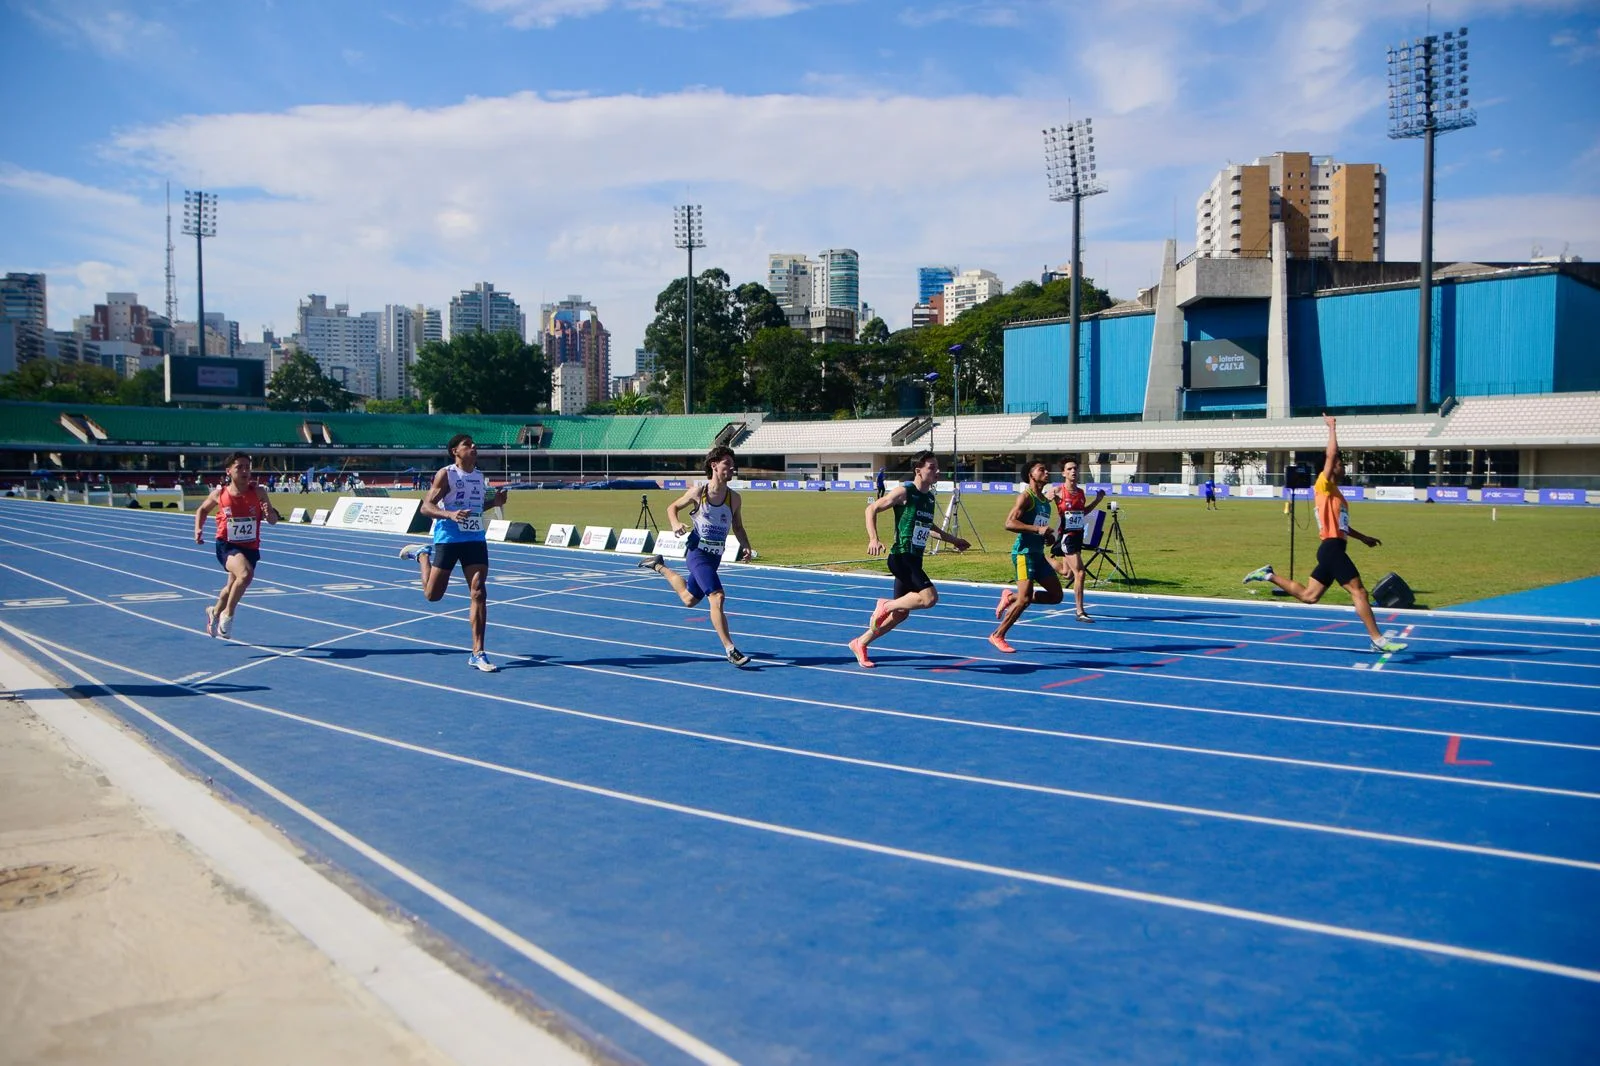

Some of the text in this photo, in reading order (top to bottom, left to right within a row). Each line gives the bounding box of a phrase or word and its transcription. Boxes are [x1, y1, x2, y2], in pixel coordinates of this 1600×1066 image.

[1219, 354, 1244, 362] loterias
[1219, 362, 1244, 371] CAIXA
[363, 505, 403, 516] ATLETISMO
[357, 514, 383, 524] BRASIL
[1069, 516, 1082, 525] 947
[462, 519, 480, 530] 526
[232, 524, 252, 536] 742
[619, 536, 637, 545] CAIXA
